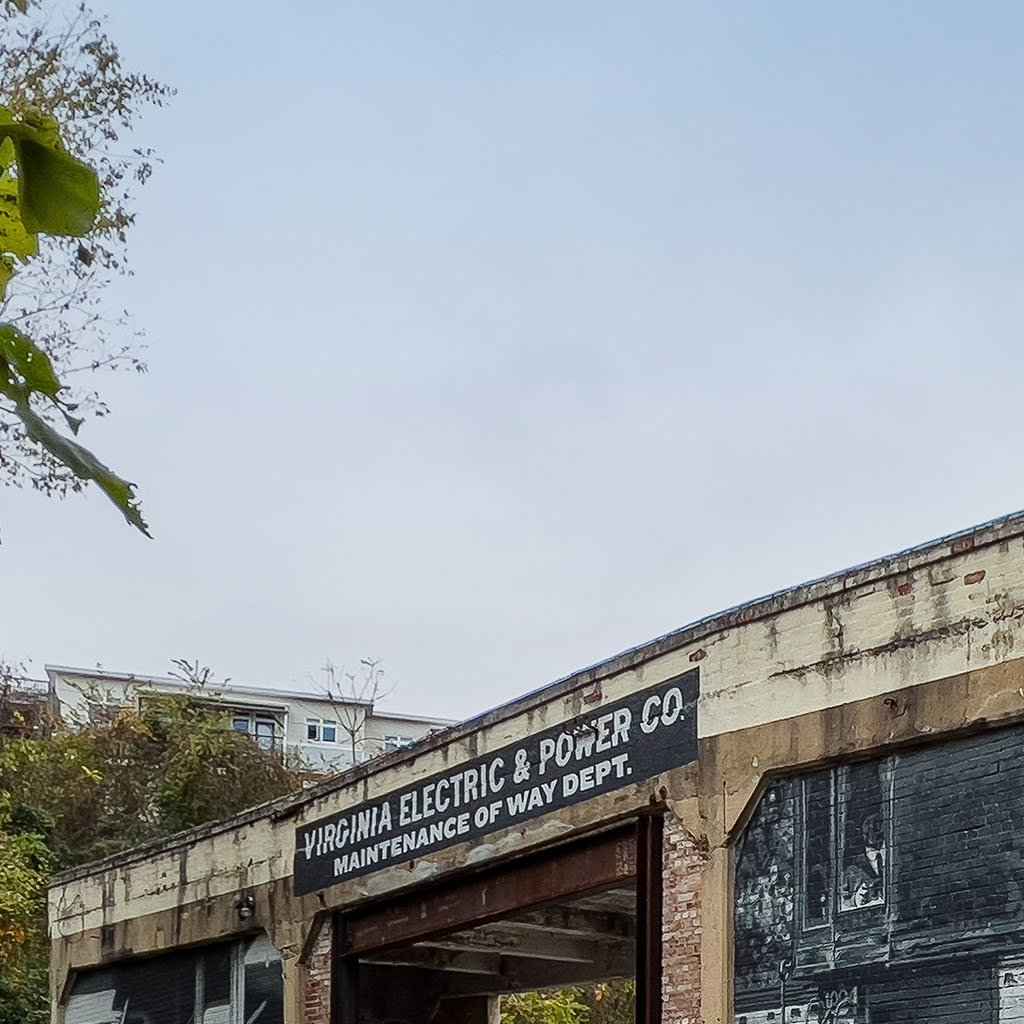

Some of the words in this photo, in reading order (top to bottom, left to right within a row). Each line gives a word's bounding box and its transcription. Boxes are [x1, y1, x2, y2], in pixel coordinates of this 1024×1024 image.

[304, 801, 392, 860] VIRGINIA
[400, 757, 505, 827] ELECTRIC
[513, 749, 531, 784] &
[538, 708, 632, 775] POWER
[640, 687, 685, 734] CO.
[333, 812, 470, 877] MAINTENANCE
[474, 800, 503, 829] OF
[507, 779, 558, 817] WAY
[562, 753, 633, 798] DEPT.
